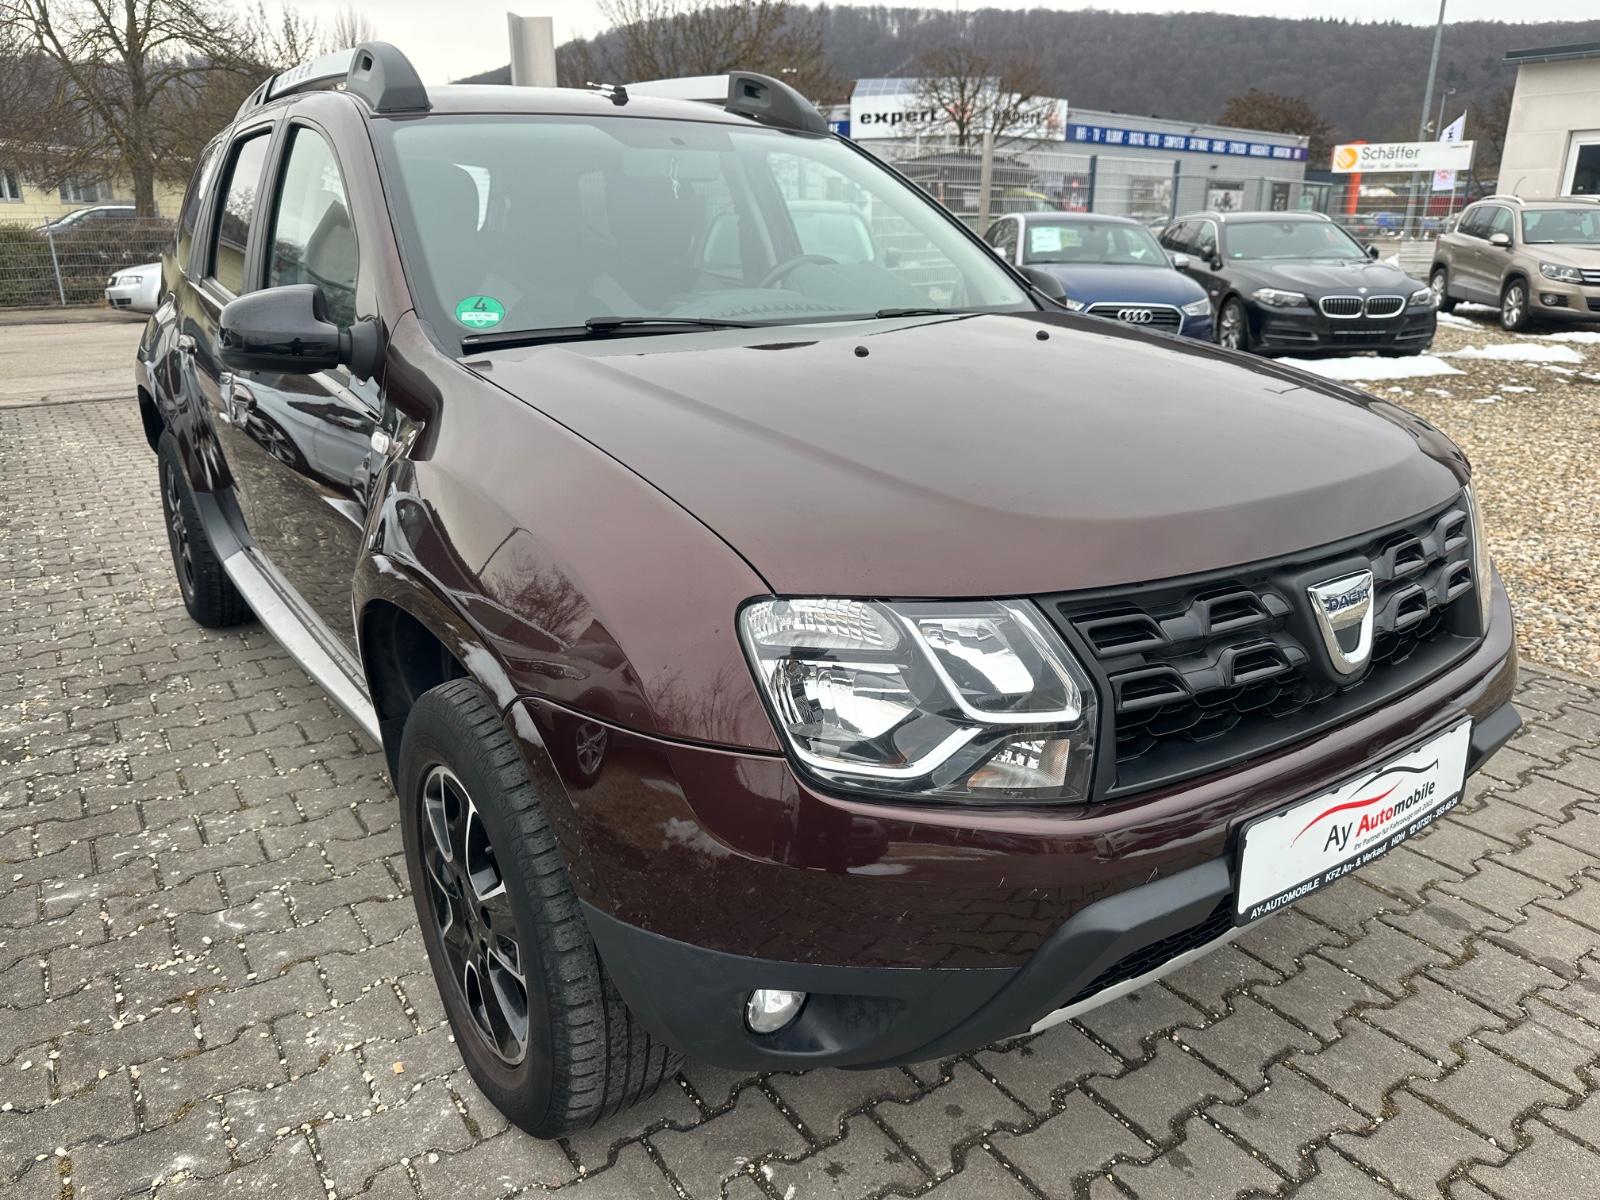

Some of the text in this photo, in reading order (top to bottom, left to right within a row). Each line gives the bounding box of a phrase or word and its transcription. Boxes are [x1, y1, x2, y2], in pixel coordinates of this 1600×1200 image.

[860, 108, 939, 126] expert
[1361, 145, 1420, 160] Schäffer
[473, 297, 487, 311] 4
[1323, 781, 1435, 852] Ay Automobile
[1250, 877, 1320, 920] AY-AUTOMOBILE
[1325, 867, 1342, 883] KFZ
[1355, 856, 1362, 868] &
[1362, 842, 1387, 863] Verkauf
